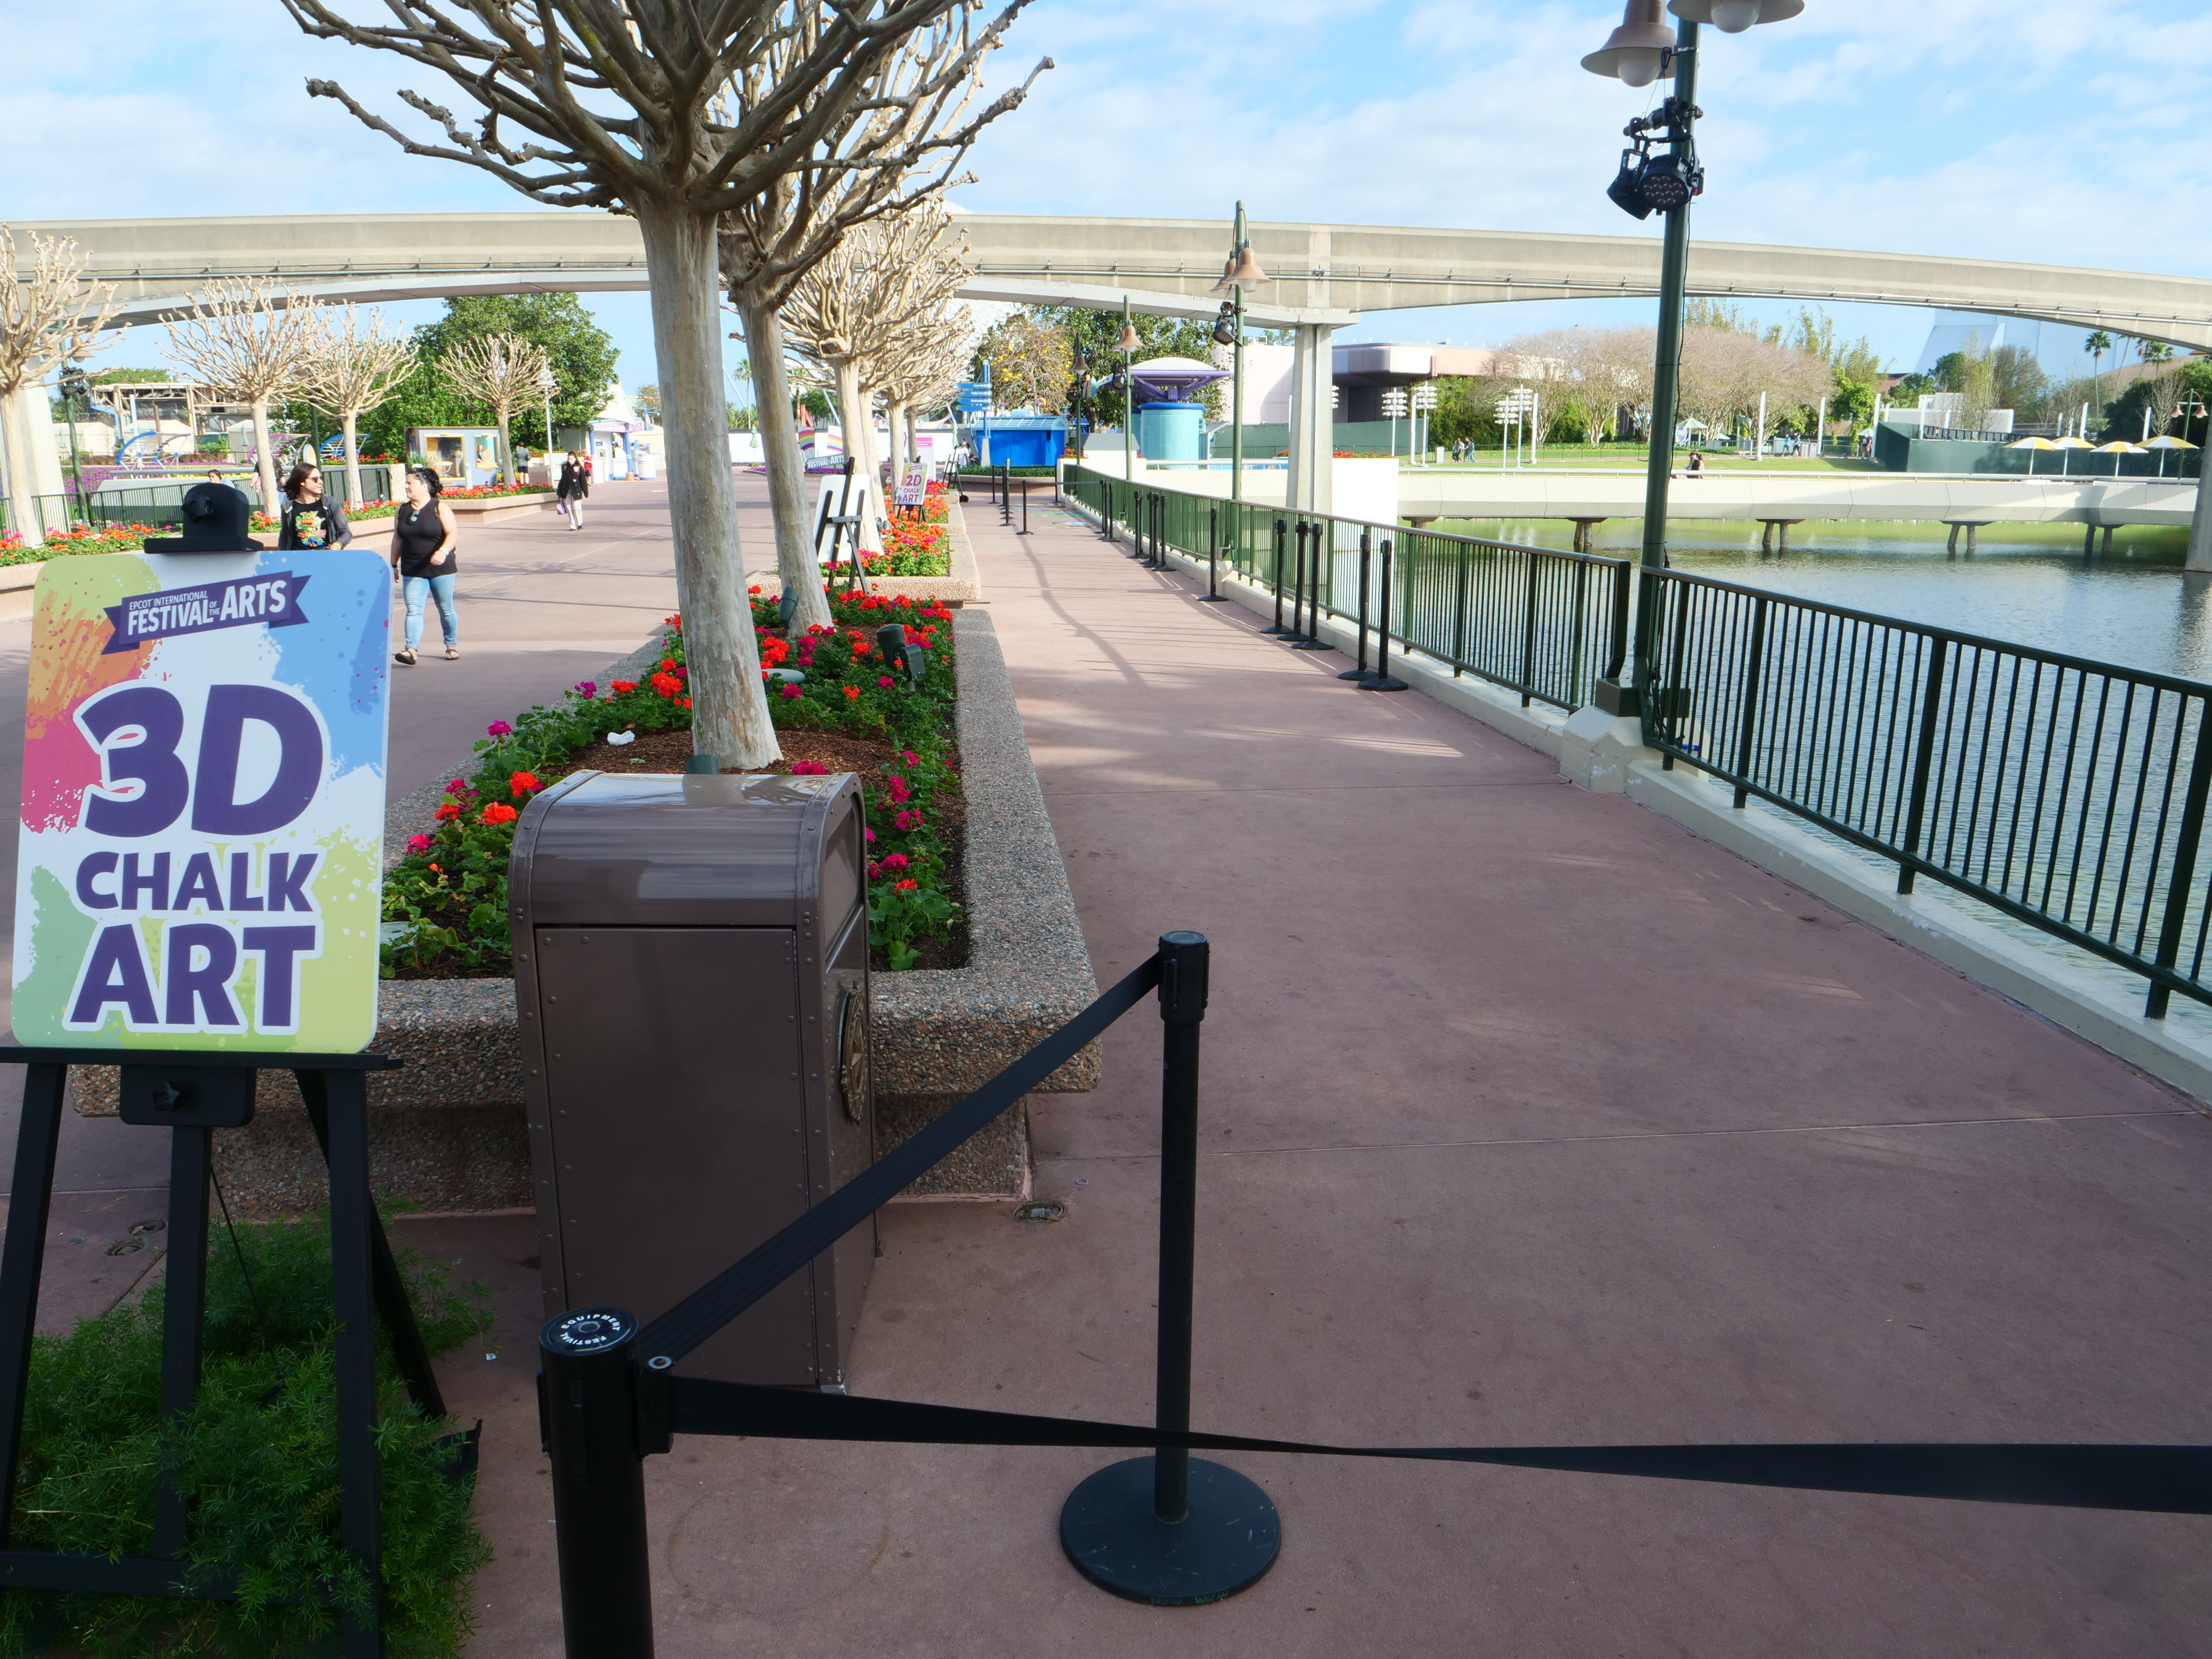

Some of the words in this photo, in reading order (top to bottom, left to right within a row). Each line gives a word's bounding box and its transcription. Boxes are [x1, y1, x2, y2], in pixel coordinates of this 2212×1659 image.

[808, 458, 830, 468] FESTIVAL
[906, 474, 922, 486] 2D
[902, 494, 919, 502] ART
[128, 599, 214, 635] FESTIVAL
[209, 608, 220, 616] THE
[219, 580, 287, 621] ARTS
[129, 599, 152, 611] EPCOT
[153, 591, 208, 606] INTERNATIONAL
[80, 684, 324, 838] 3D
[76, 851, 319, 913] CHALK
[69, 923, 318, 1027] ART
[561, 1314, 621, 1331] EQUIPMENT
[560, 1332, 607, 1346] FESTIVAL
